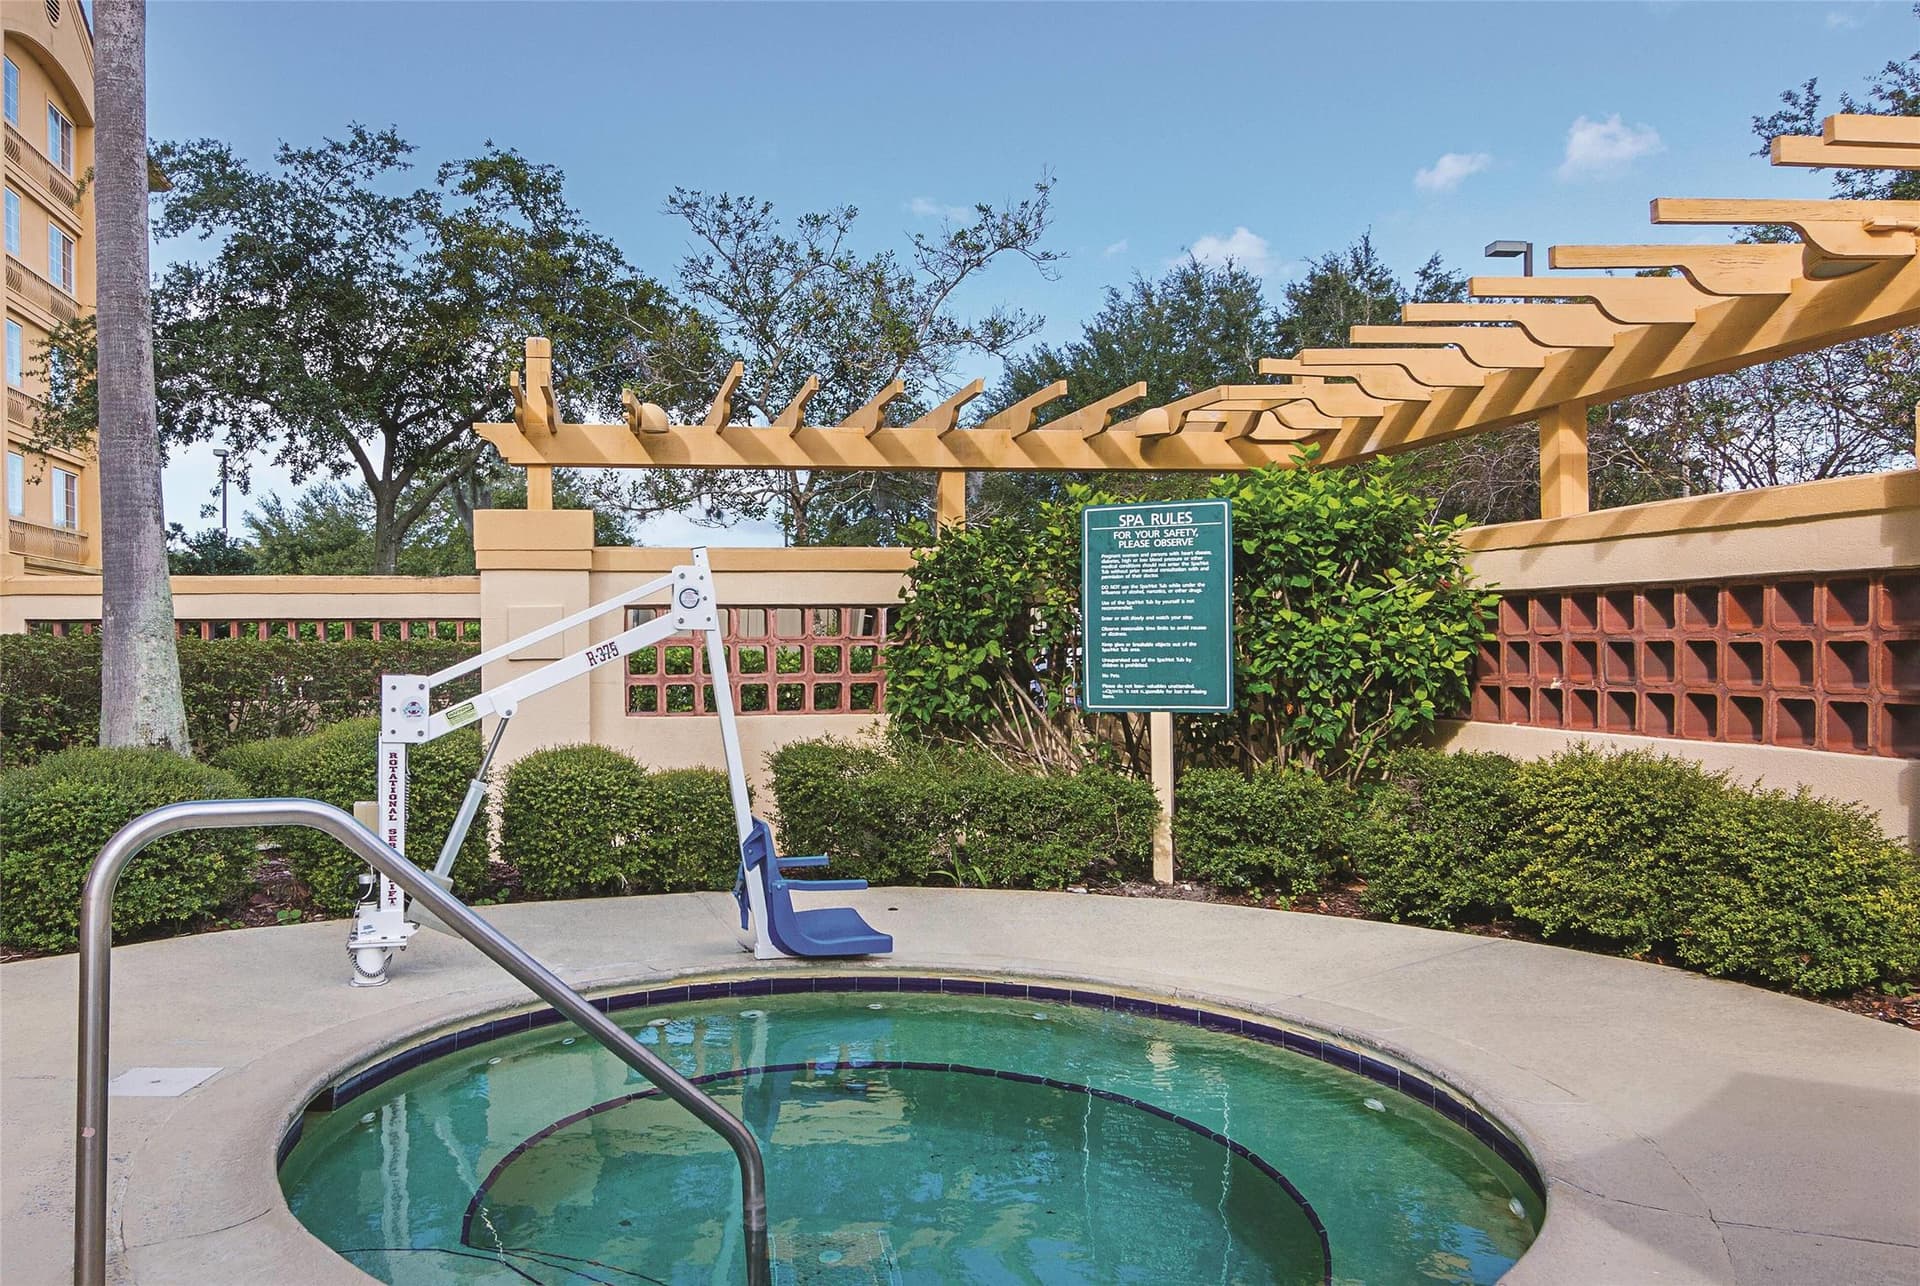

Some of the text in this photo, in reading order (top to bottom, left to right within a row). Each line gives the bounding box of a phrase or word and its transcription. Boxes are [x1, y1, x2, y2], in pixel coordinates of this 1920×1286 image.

[1118, 511, 1193, 527] SPA RULES
[1113, 527, 1199, 539] FOR YOUR SAFETY,
[1118, 537, 1194, 548] PLEASE OBSERVE
[585, 641, 619, 667] R-375
[388, 752, 398, 821] ROTATIONAL
